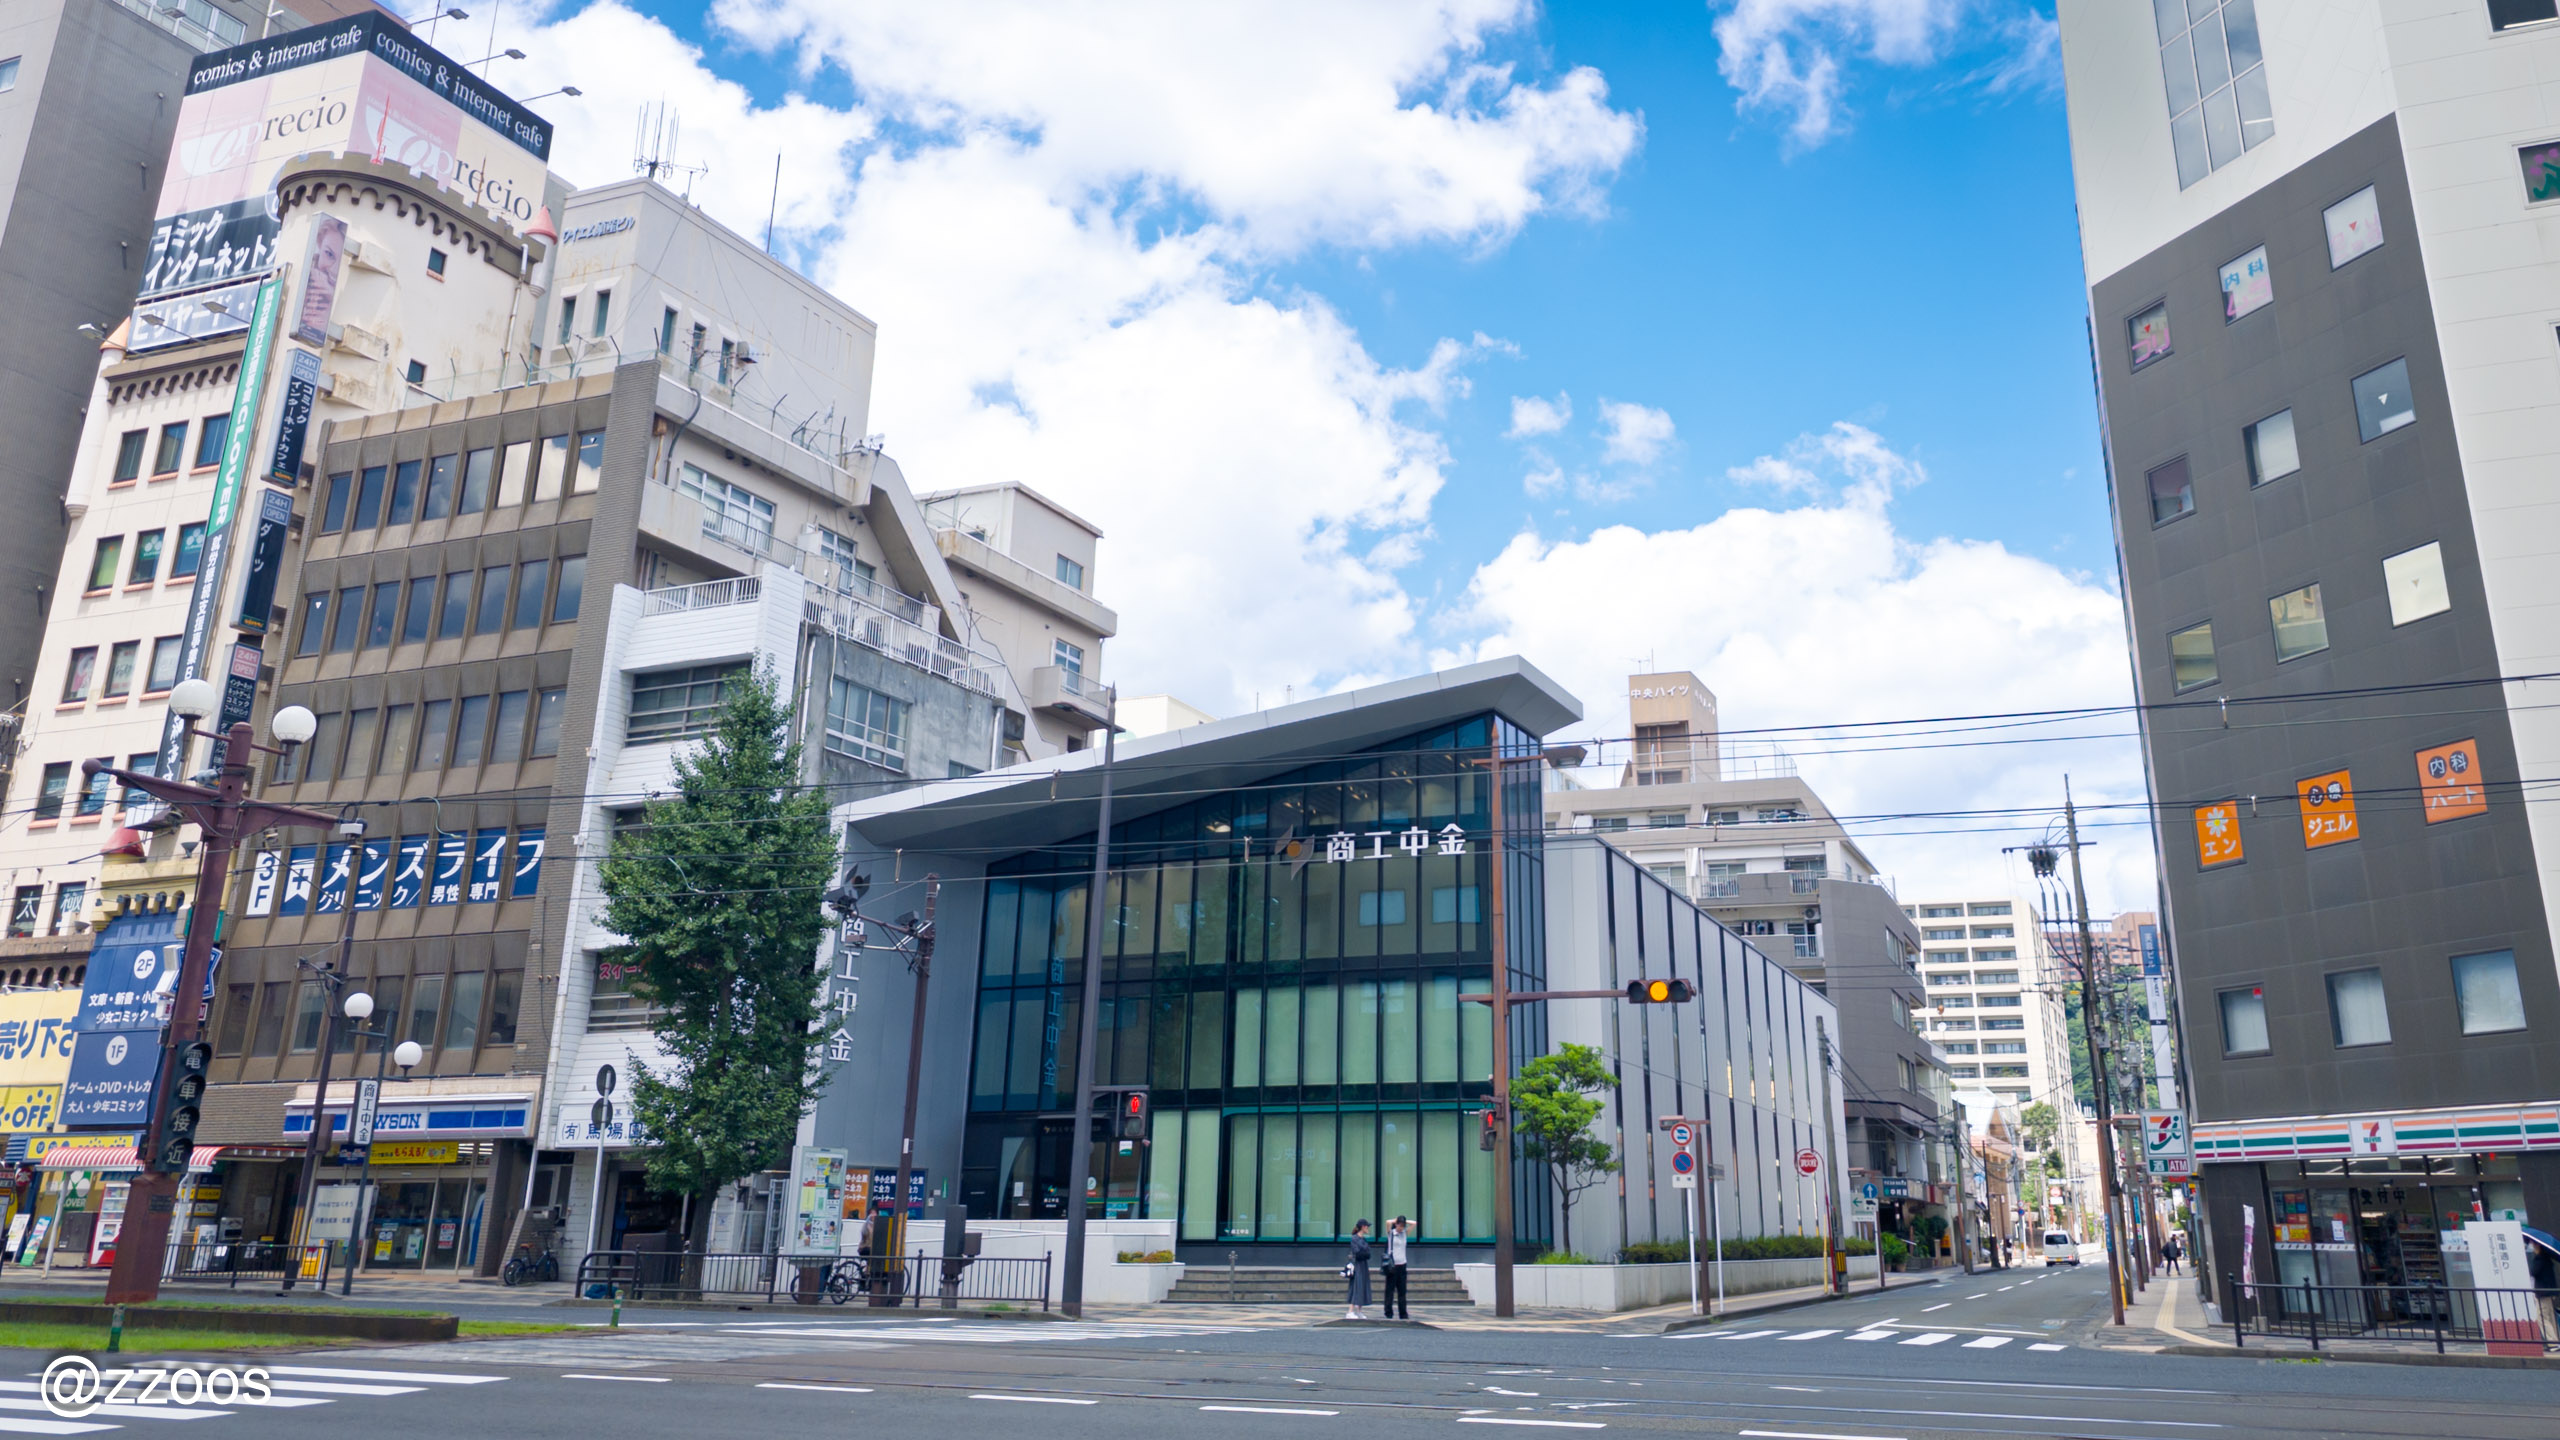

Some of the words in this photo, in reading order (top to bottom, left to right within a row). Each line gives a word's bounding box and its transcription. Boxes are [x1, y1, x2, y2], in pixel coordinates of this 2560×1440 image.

[194, 58, 245, 85] comics
[249, 50, 263, 70] &
[267, 37, 328, 65] internet
[331, 24, 362, 49] cafe
[376, 32, 432, 76] comics
[435, 64, 451, 89] &
[454, 76, 512, 128] internet
[515, 119, 543, 148] cafe
[154, 210, 224, 251] コミック
[2224, 257, 2265, 291] 内科
[132, 294, 256, 342] ビリヤード・
[295, 367, 314, 380] OPEN
[298, 356, 316, 369] 24H
[297, 384, 314, 424] コミック
[277, 381, 301, 470] インターネットカフェ
[216, 405, 249, 526] CLOVER
[269, 495, 288, 508] 24H
[266, 508, 285, 520] OPEN
[254, 522, 273, 573] ダーツ
[237, 650, 258, 663] 24H
[234, 664, 255, 676] OPEN
[226, 697, 249, 707] コミック
[1631, 685, 1689, 700] 中央ハイツ
[2430, 752, 2467, 776] 内科
[2432, 785, 2477, 809] ハート
[2308, 814, 2352, 837] ジェル
[1326, 823, 1467, 863] 商工中金
[2205, 838, 2236, 857] エン
[322, 836, 545, 889] メンズライフ
[254, 856, 276, 908] 3F
[137, 957, 154, 973] 2F
[600, 963, 641, 980] スイー
[828, 917, 864, 1062] 商工中金
[111, 1044, 124, 1059] 1F
[66, 1100, 145, 1113] 大人・少年コミック
[167, 1049, 203, 1165] 電車接近
[359, 1083, 376, 1142] 商工中金
[2170, 1160, 2188, 1171] ATM
[63, 1198, 86, 1207] OVER
